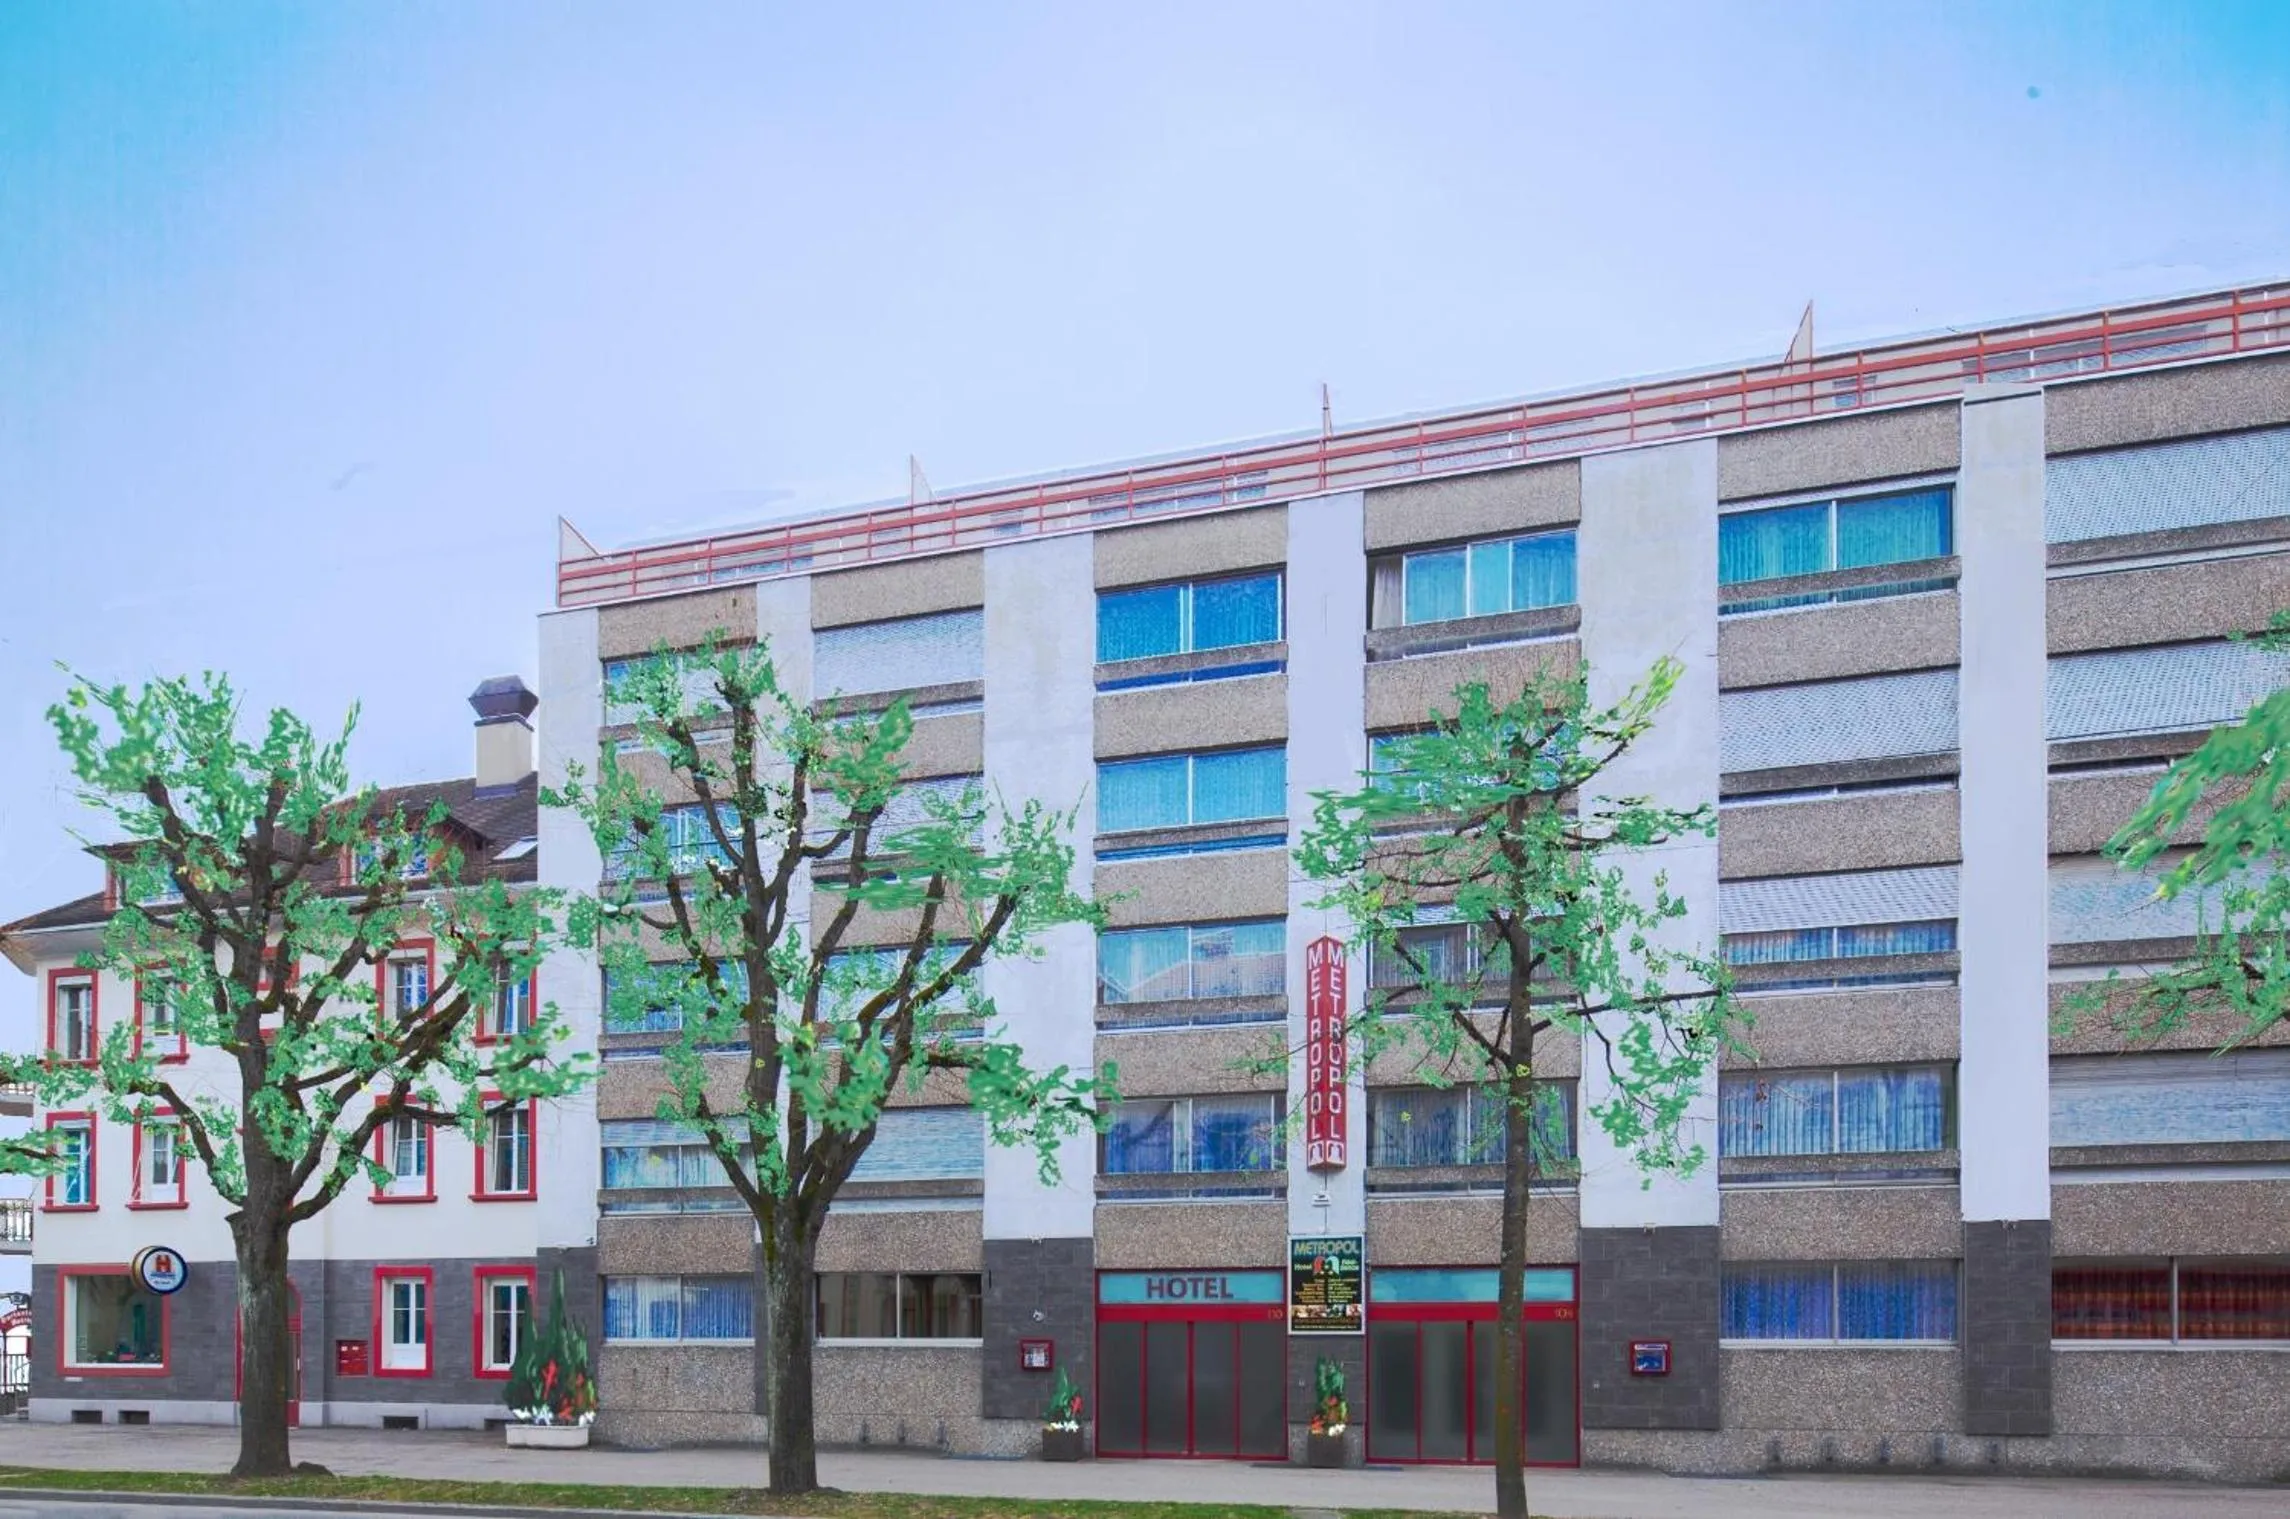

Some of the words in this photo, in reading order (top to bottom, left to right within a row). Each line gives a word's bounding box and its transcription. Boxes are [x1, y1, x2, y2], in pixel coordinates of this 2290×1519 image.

[1308, 942, 1323, 1140] METROPOL
[1327, 944, 1345, 1140] METROPOL
[1146, 1277, 1234, 1299] HOTEL
[1294, 1240, 1360, 1256] METROPOL
